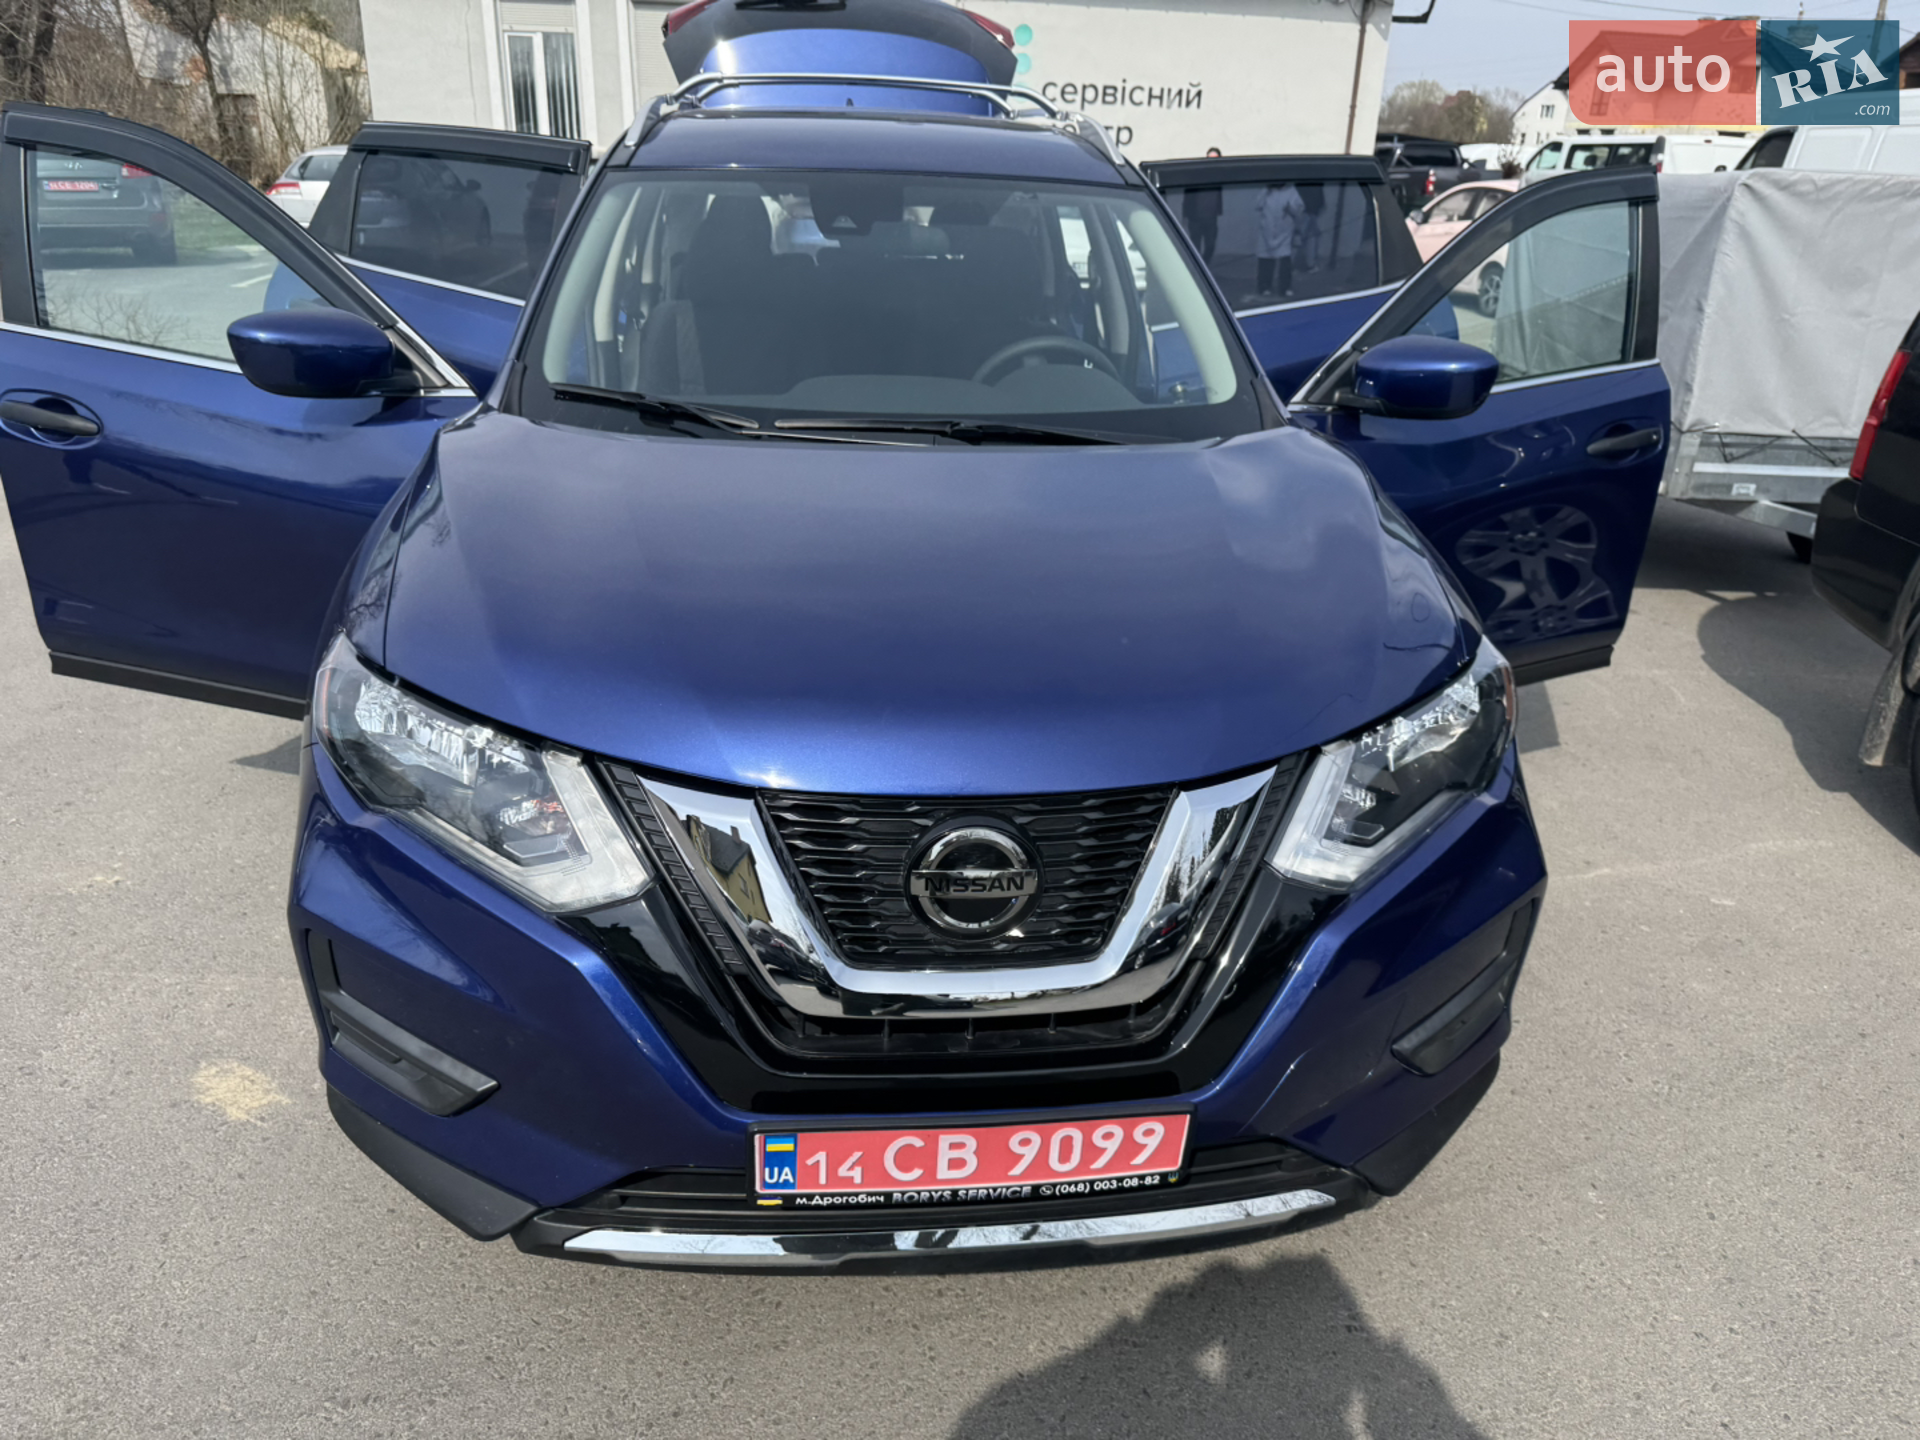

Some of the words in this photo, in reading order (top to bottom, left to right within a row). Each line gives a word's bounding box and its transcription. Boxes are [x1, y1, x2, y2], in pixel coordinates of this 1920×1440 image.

[1041, 78, 1203, 110] сервісний
[924, 876, 1025, 893] NISSAN
[805, 1151, 864, 1185] 14
[883, 1134, 978, 1182] CB
[1007, 1121, 1165, 1176] 9099
[764, 1166, 795, 1184] UA
[892, 1190, 952, 1204] BORYS
[957, 1186, 1032, 1201] SERVICE
[1055, 1182, 1090, 1196] (068)
